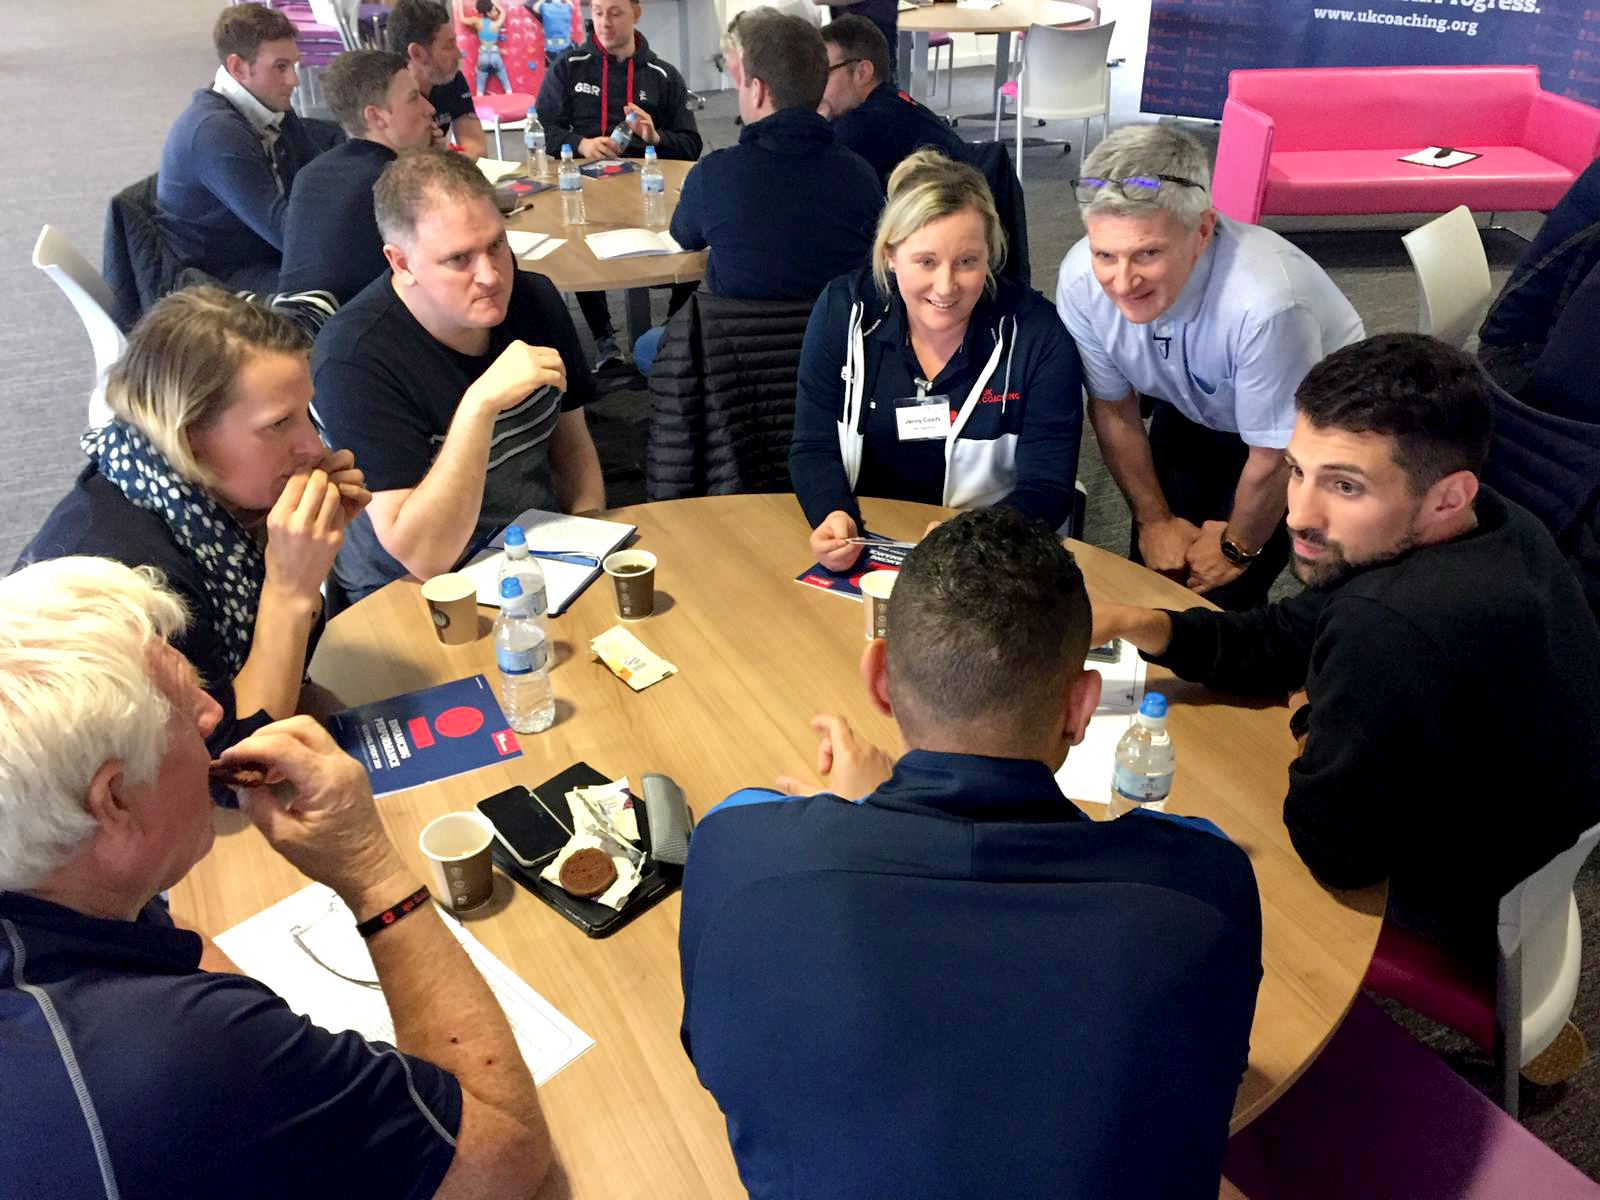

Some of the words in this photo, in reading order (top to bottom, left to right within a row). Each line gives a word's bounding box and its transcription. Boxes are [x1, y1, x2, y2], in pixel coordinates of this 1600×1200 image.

[1434, 0, 1541, 13] gress.
[1313, 8, 1480, 36] www.ukcoaching.org
[574, 82, 600, 97] GBR
[981, 392, 1021, 403] COACING
